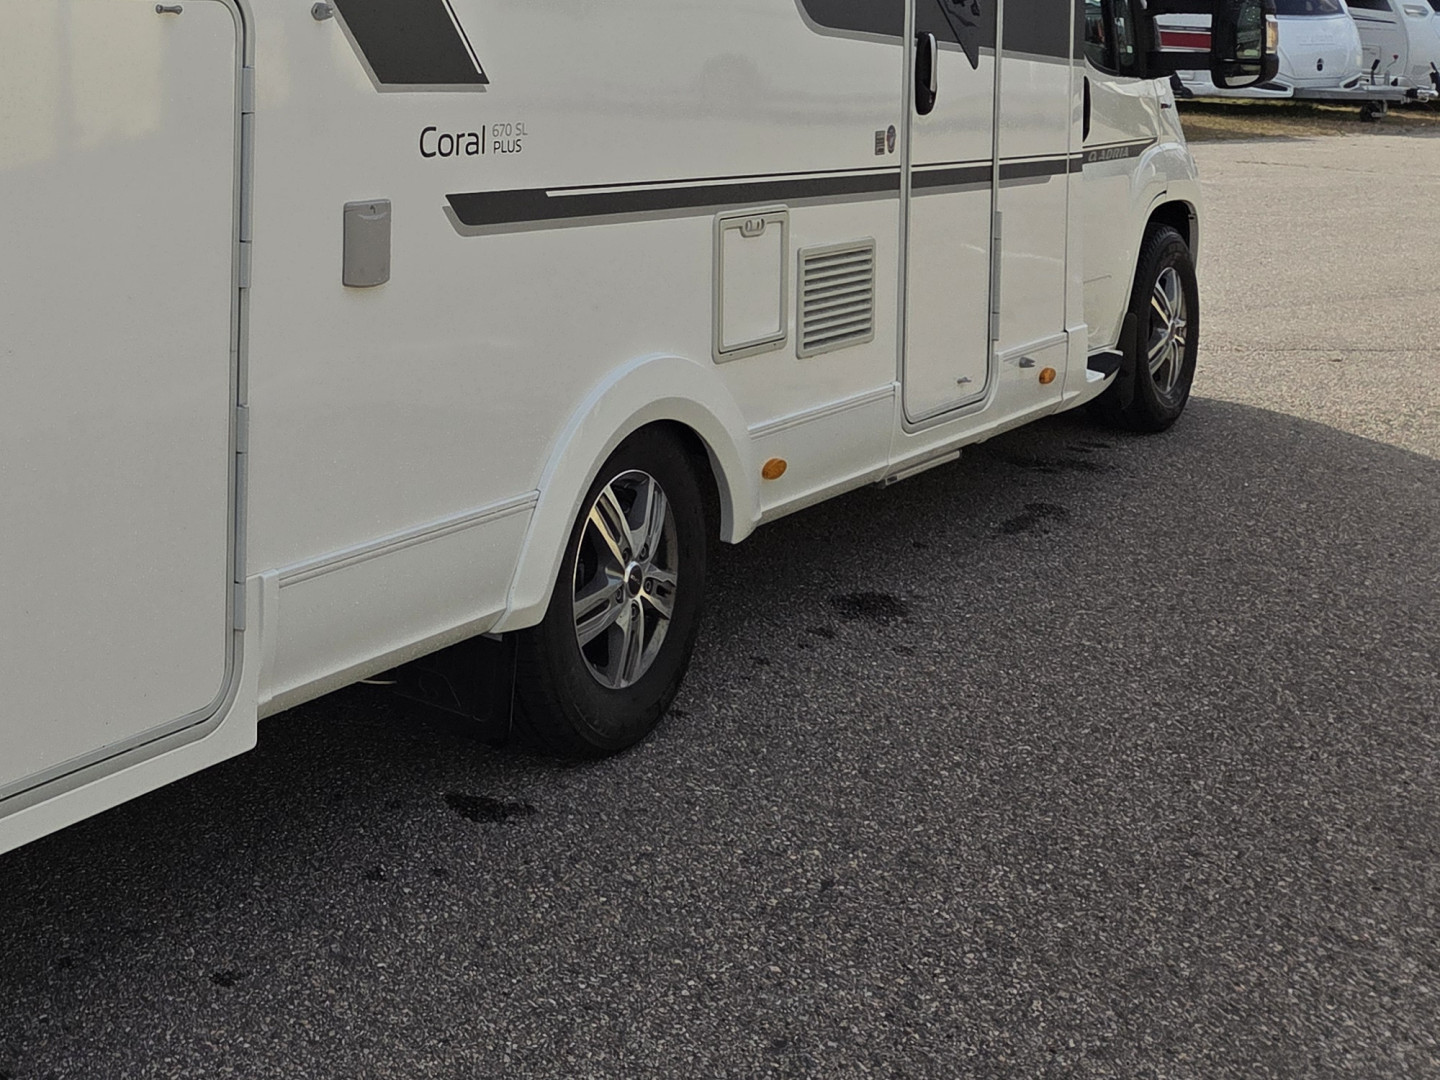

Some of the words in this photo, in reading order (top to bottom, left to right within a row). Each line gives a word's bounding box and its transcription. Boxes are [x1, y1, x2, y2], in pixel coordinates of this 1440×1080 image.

[419, 125, 486, 158] Coral
[491, 123, 513, 138] 670
[515, 122, 528, 137] SL
[493, 138, 522, 155] PLUS
[1098, 146, 1129, 161] ADRIA
